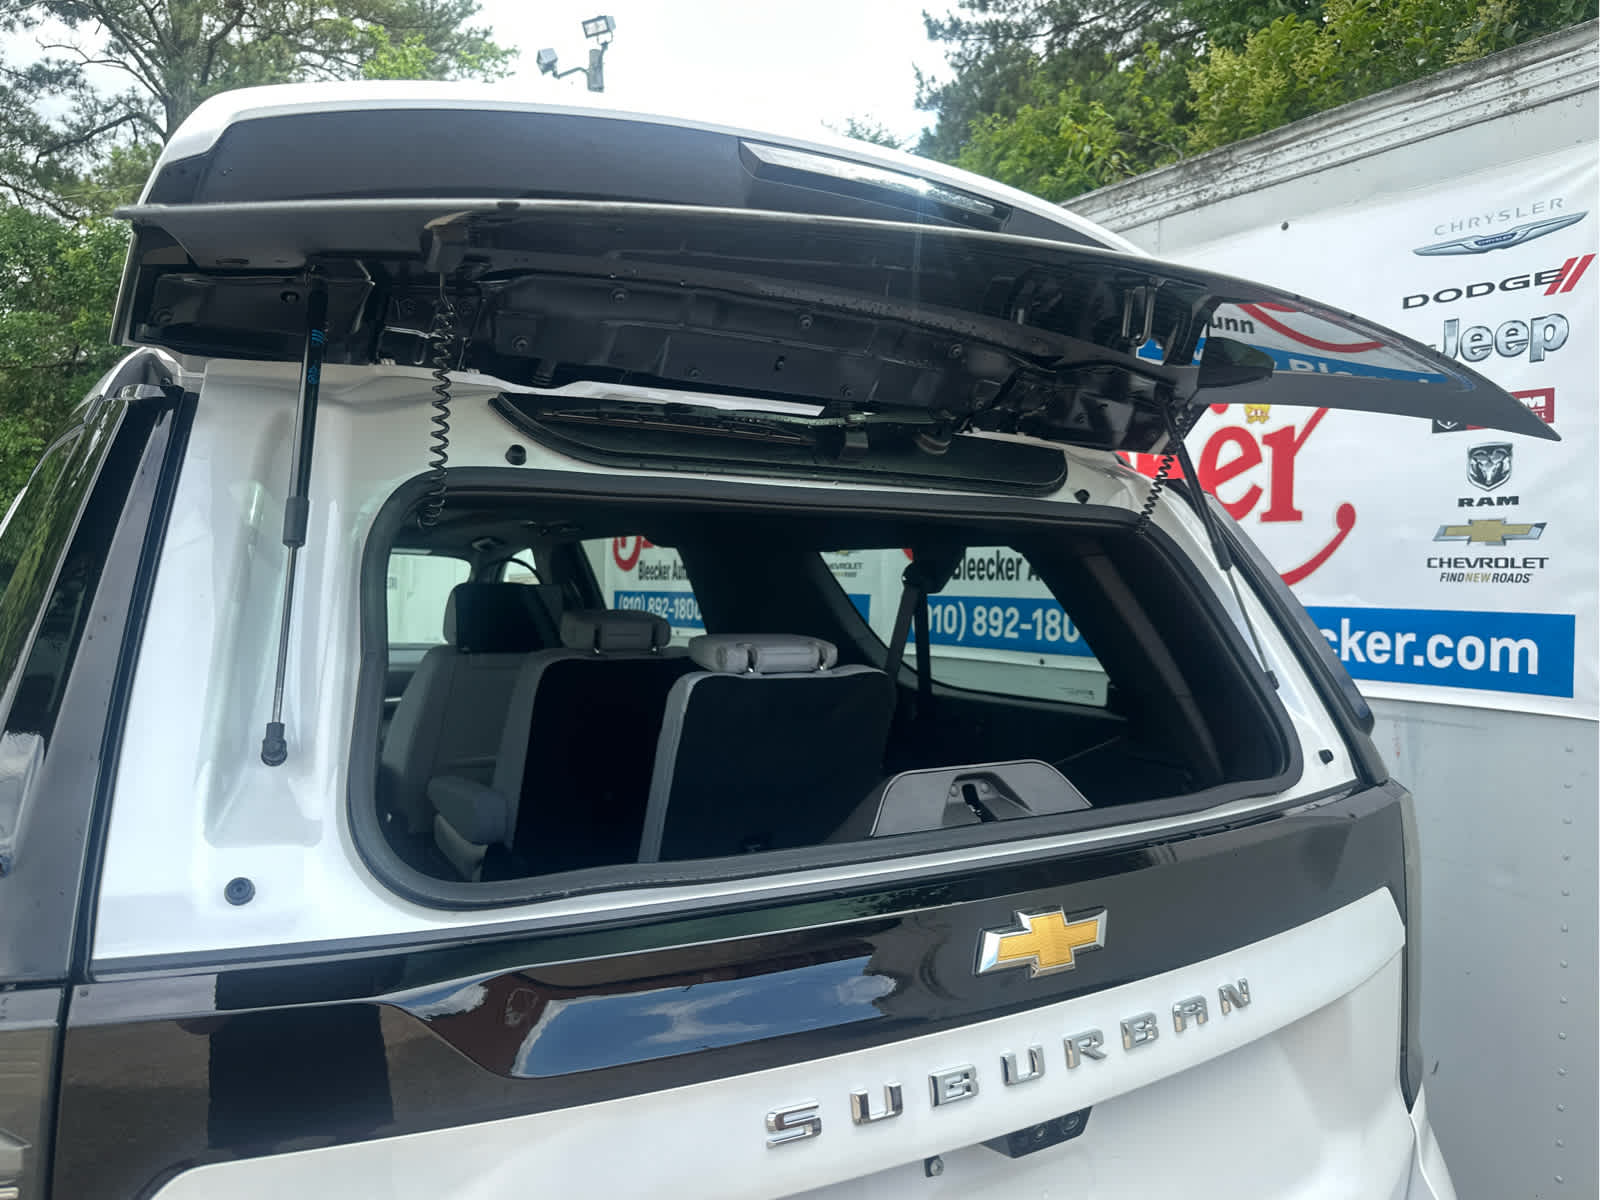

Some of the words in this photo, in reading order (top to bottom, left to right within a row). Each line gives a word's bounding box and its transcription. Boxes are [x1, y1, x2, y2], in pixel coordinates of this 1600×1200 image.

[1434, 198, 1564, 236] CHRYSLER
[1402, 268, 1565, 309] DODGE
[1428, 313, 1570, 363] Jeep
[1457, 495, 1520, 508] RAM
[638, 559, 671, 581] Bleecker
[1427, 557, 1549, 569] CHEVROLET
[765, 976, 1253, 1149] SUBURBAN
